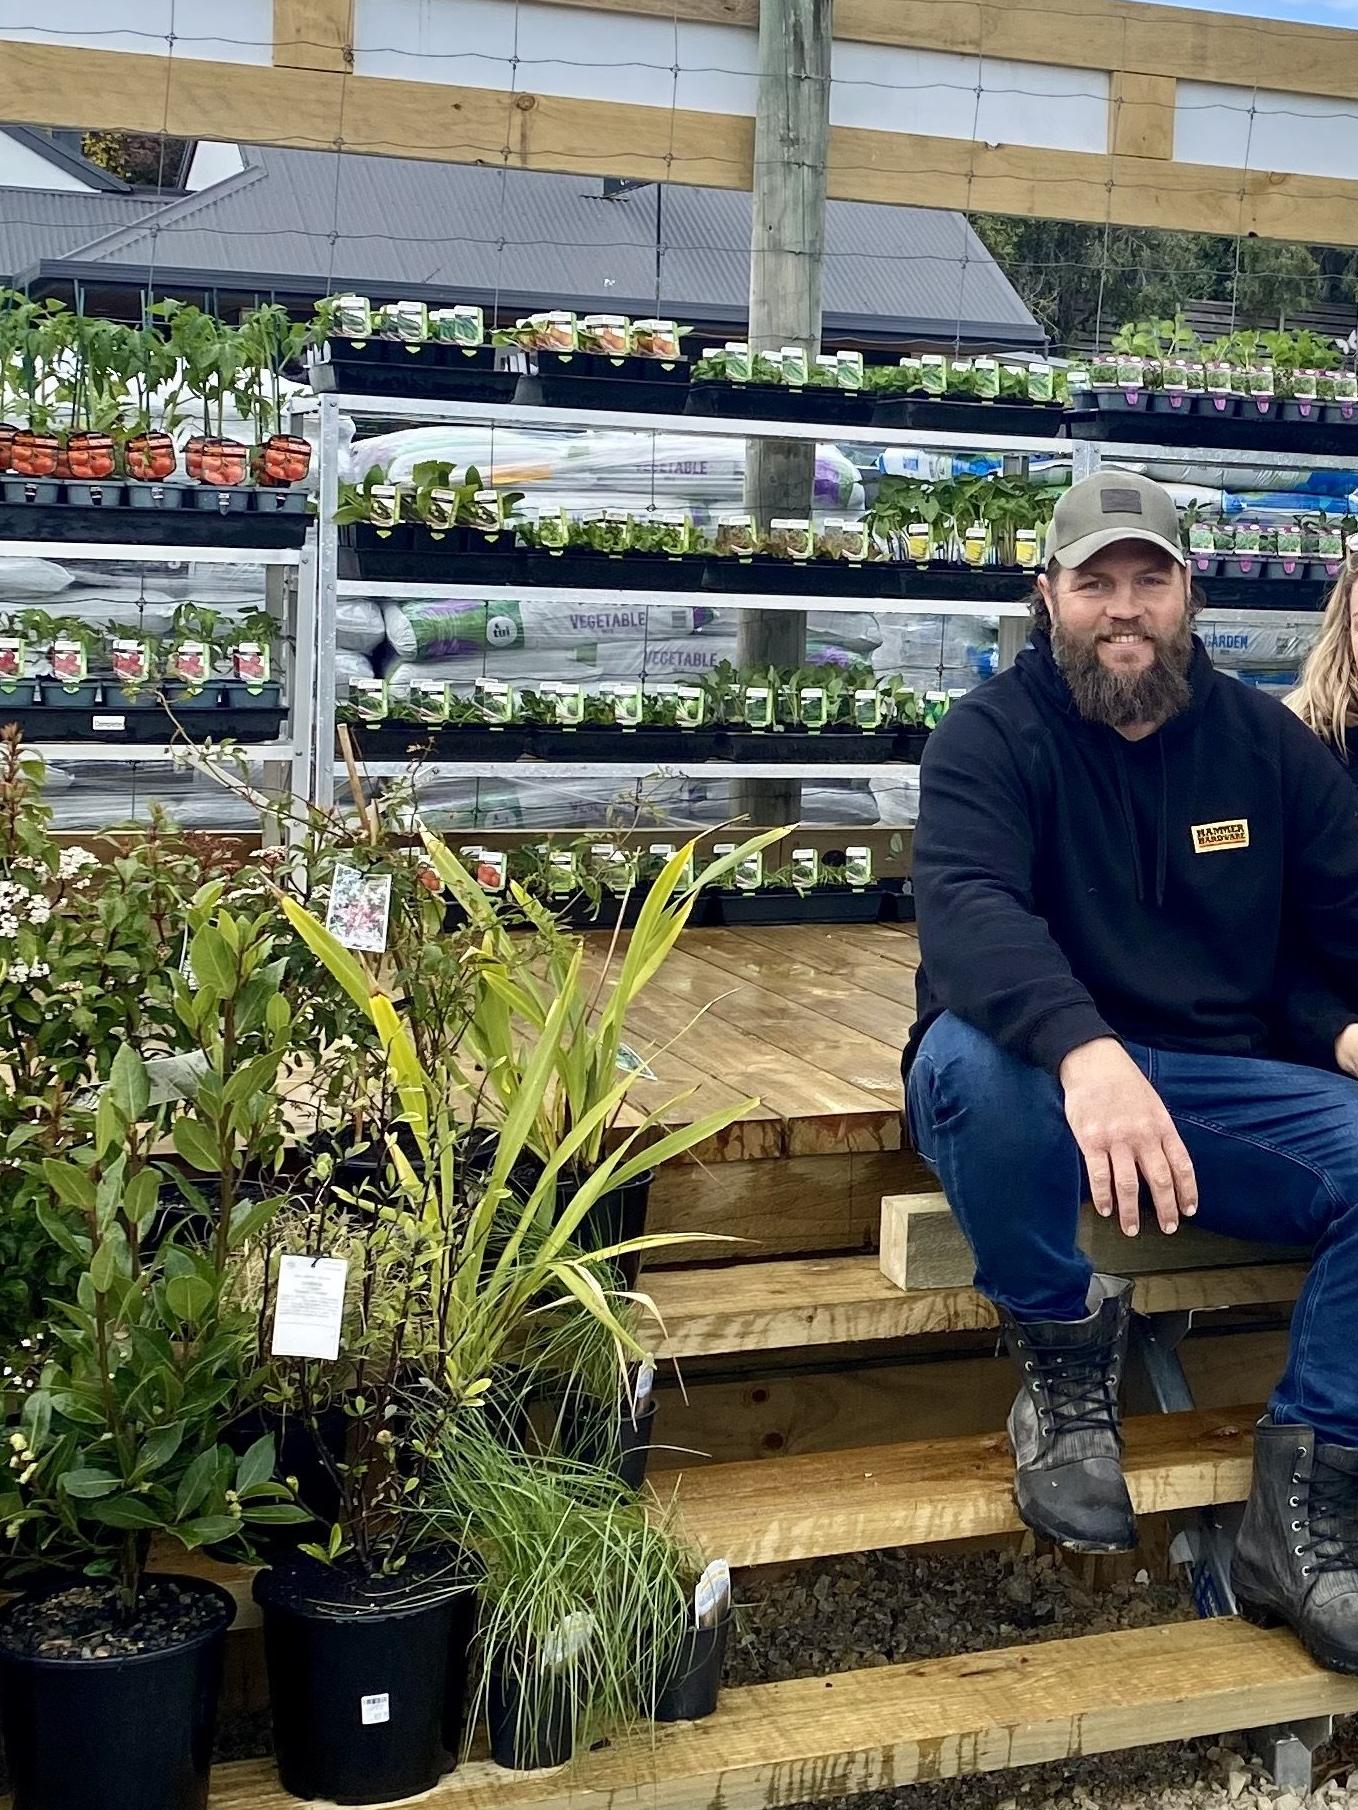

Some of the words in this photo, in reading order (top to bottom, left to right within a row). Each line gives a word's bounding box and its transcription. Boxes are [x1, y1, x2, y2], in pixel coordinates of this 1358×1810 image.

[633, 461, 709, 475] ETABLE
[569, 611, 646, 629] VEGETABLE
[1204, 634, 1249, 649] GARDEN
[646, 650, 718, 667] VEGETABLE
[1196, 823, 1245, 838] HAMMER
[1198, 832, 1246, 844] HARDWARE
